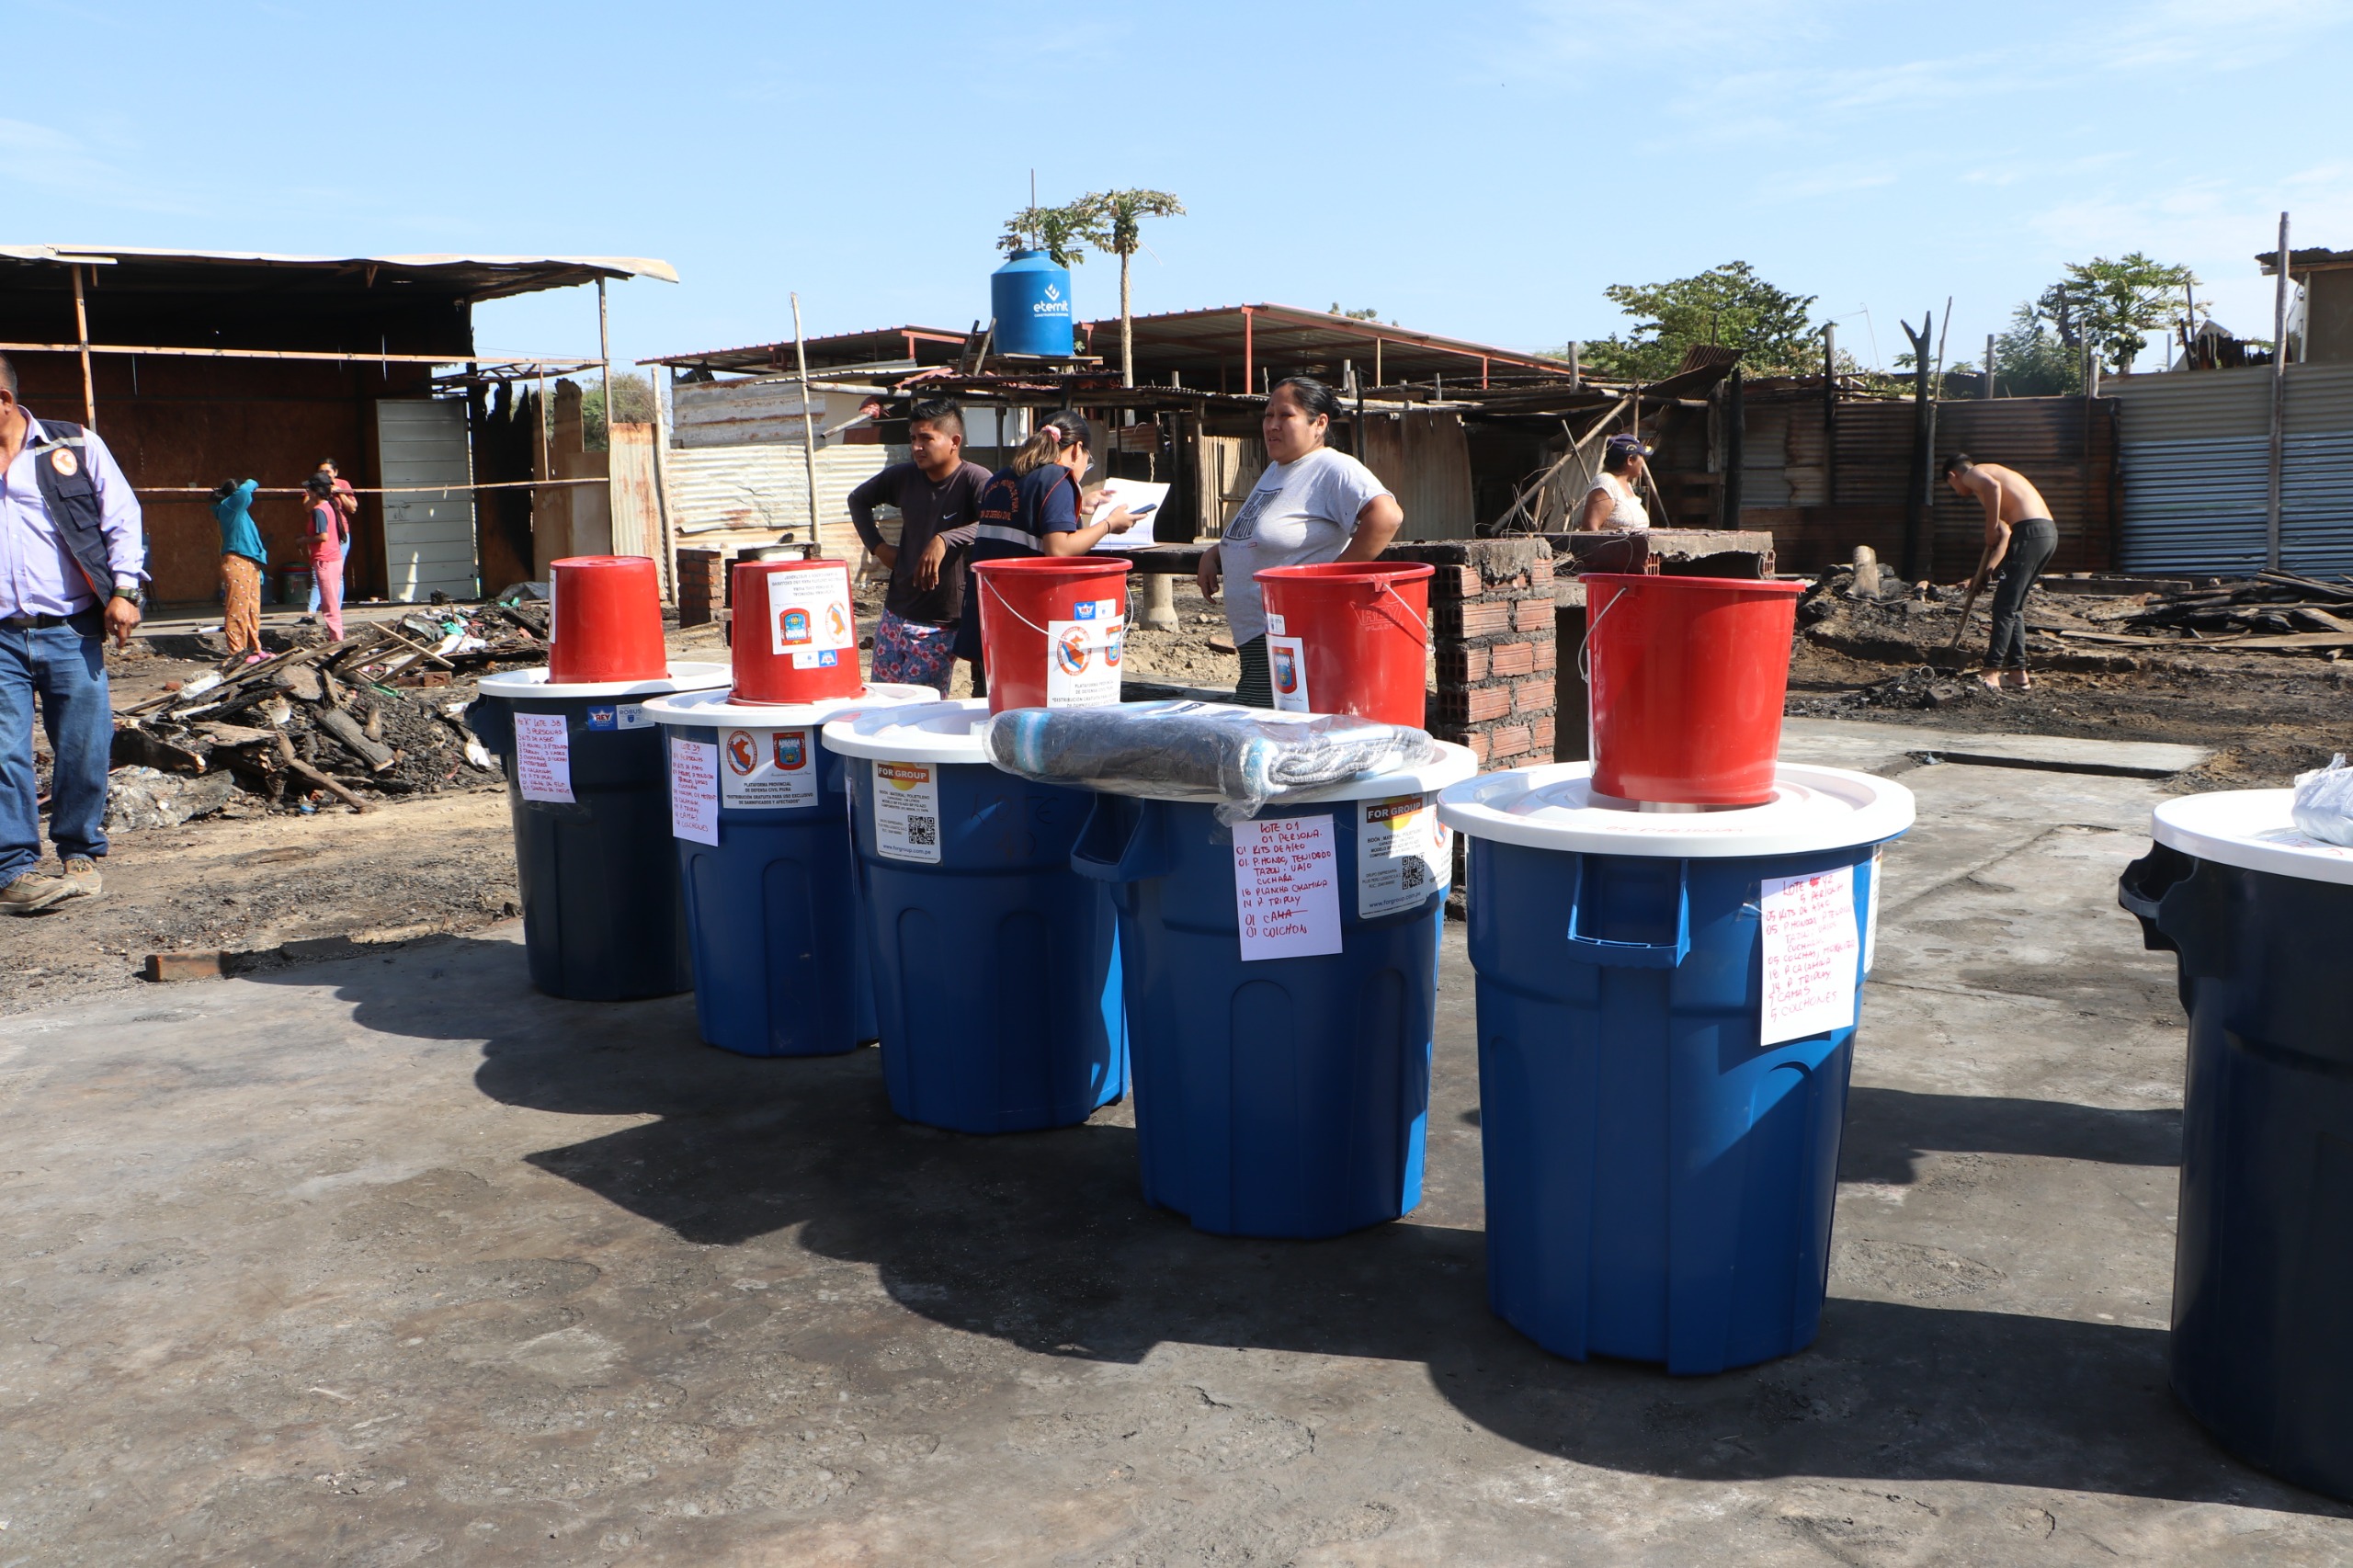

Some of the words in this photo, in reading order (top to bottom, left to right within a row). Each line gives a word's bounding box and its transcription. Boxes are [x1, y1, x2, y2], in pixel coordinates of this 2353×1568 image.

[1033, 300, 1069, 312] eternit
[533, 718, 547, 727] LOTE
[878, 767, 894, 777] FOR
[894, 769, 926, 779] GROUP
[1368, 809, 1390, 820] FOR
[1390, 801, 1421, 816] GROUP
[1260, 823, 1280, 834] LOTE
[1286, 821, 1300, 830] 01
[1235, 846, 1246, 855] 01
[1253, 845, 1270, 855] KITS
[1273, 845, 1284, 853] DE
[1253, 867, 1279, 877] TAZON
[1290, 862, 1313, 872] VASO
[1242, 889, 1252, 897] 18
[1256, 885, 1289, 897] PLANCHA
[1783, 880, 1804, 896] LOTE
[1244, 899, 1252, 909] 14
[1268, 895, 1301, 907] TRIPLAY
[1245, 914, 1256, 926] 01
[1779, 908, 1796, 922] KITS
[1246, 926, 1257, 938] 01
[1263, 923, 1308, 937] COLCHON
[1766, 925, 1779, 936] 05
[1777, 986, 1811, 1003] CAMAS
[1780, 991, 1837, 1017] COLCHONES
